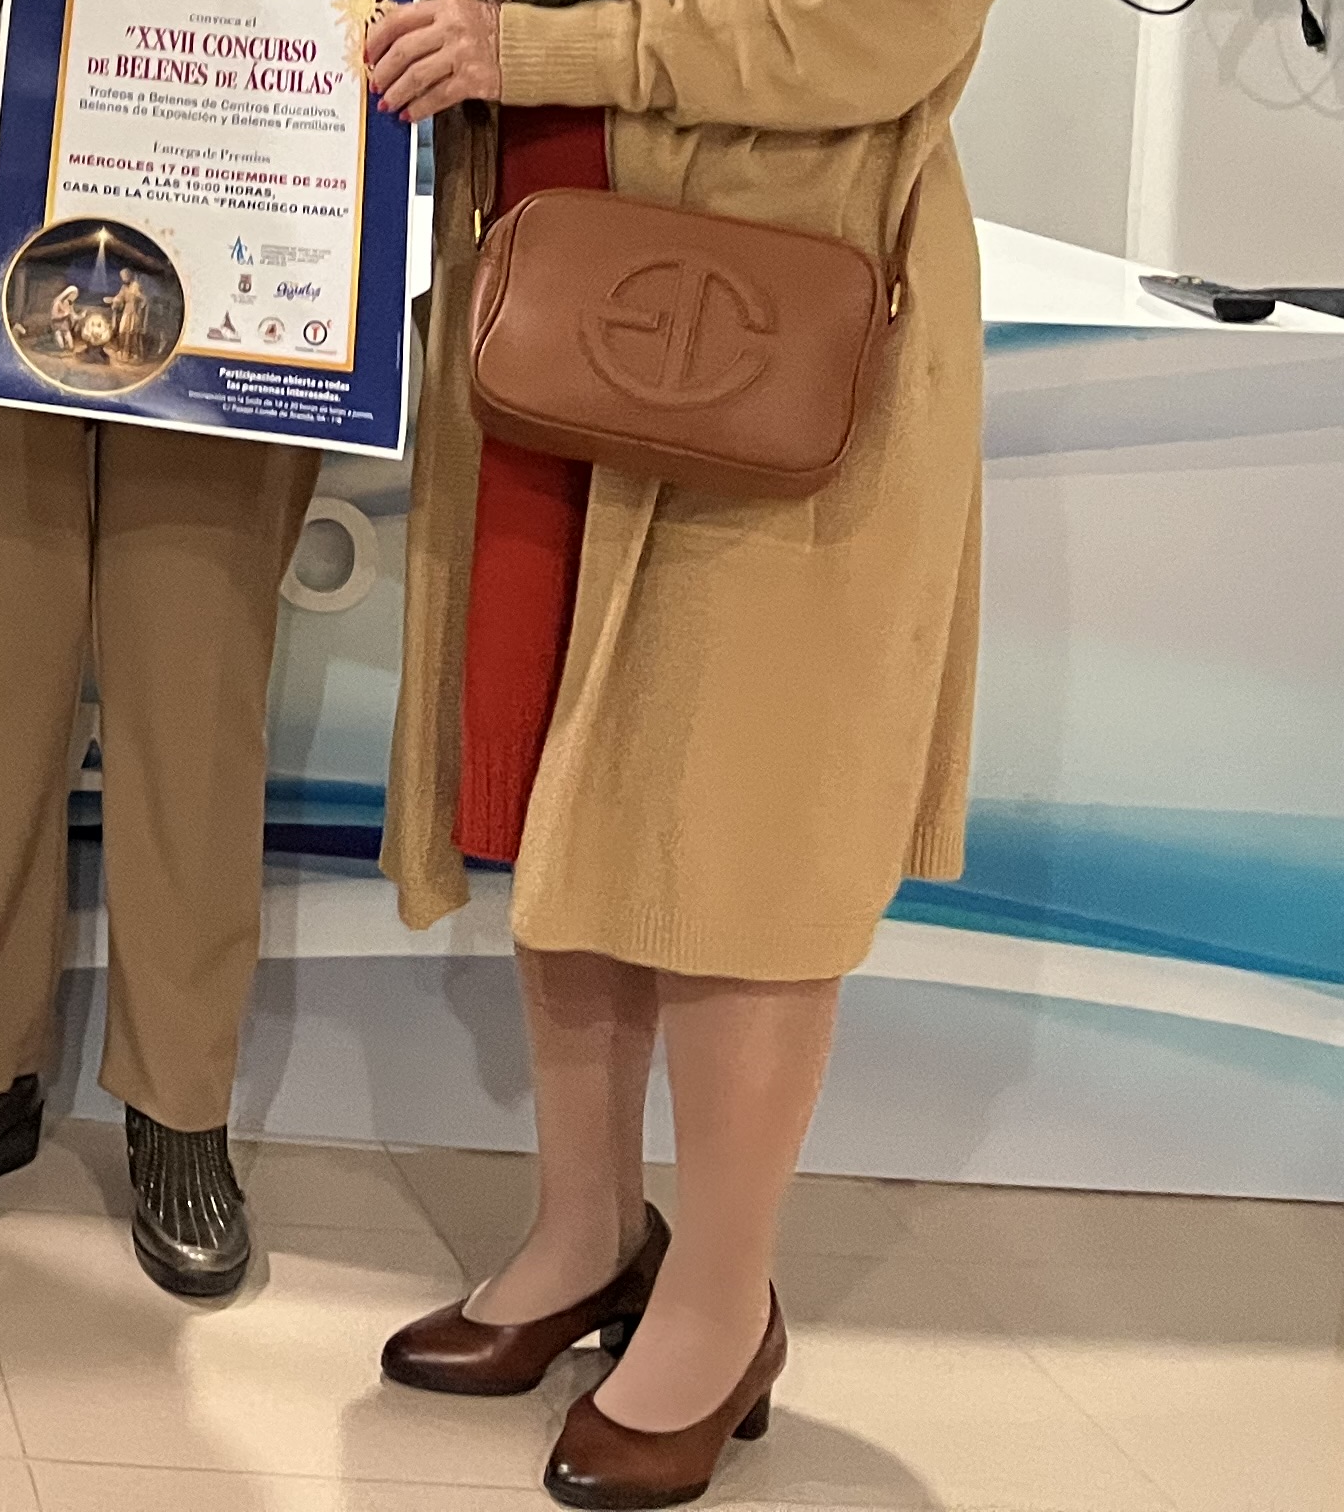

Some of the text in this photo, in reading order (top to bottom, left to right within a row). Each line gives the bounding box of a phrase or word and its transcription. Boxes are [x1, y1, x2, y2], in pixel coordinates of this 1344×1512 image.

[189, 13, 256, 27] convoca el
[125, 25, 316, 63] "XXVII CONCURSO
[87, 54, 343, 95] DE BELENES DE ÁGUILAS"
[79, 98, 129, 113] Belenes
[152, 105, 216, 123] Exposición
[232, 112, 281, 128] Belenes
[285, 117, 345, 133] Familiares
[89, 85, 133, 101] Trofeos
[149, 91, 198, 107] Belenes
[221, 98, 269, 114] Centros
[273, 102, 339, 119] Educativos,
[68, 153, 154, 172] MIÉRCOLES
[162, 163, 175, 175] 17
[180, 166, 199, 177] DE
[205, 168, 287, 185] DICIEMBRE
[293, 175, 310, 187] DE
[62, 181, 98, 194] CASA
[146, 189, 209, 206] CULTURA
[213, 197, 297, 214] "FRANCISCO
[302, 204, 348, 218] RABAL"
[155, 177, 180, 189] LAS
[224, 184, 276, 200] HORAS,
